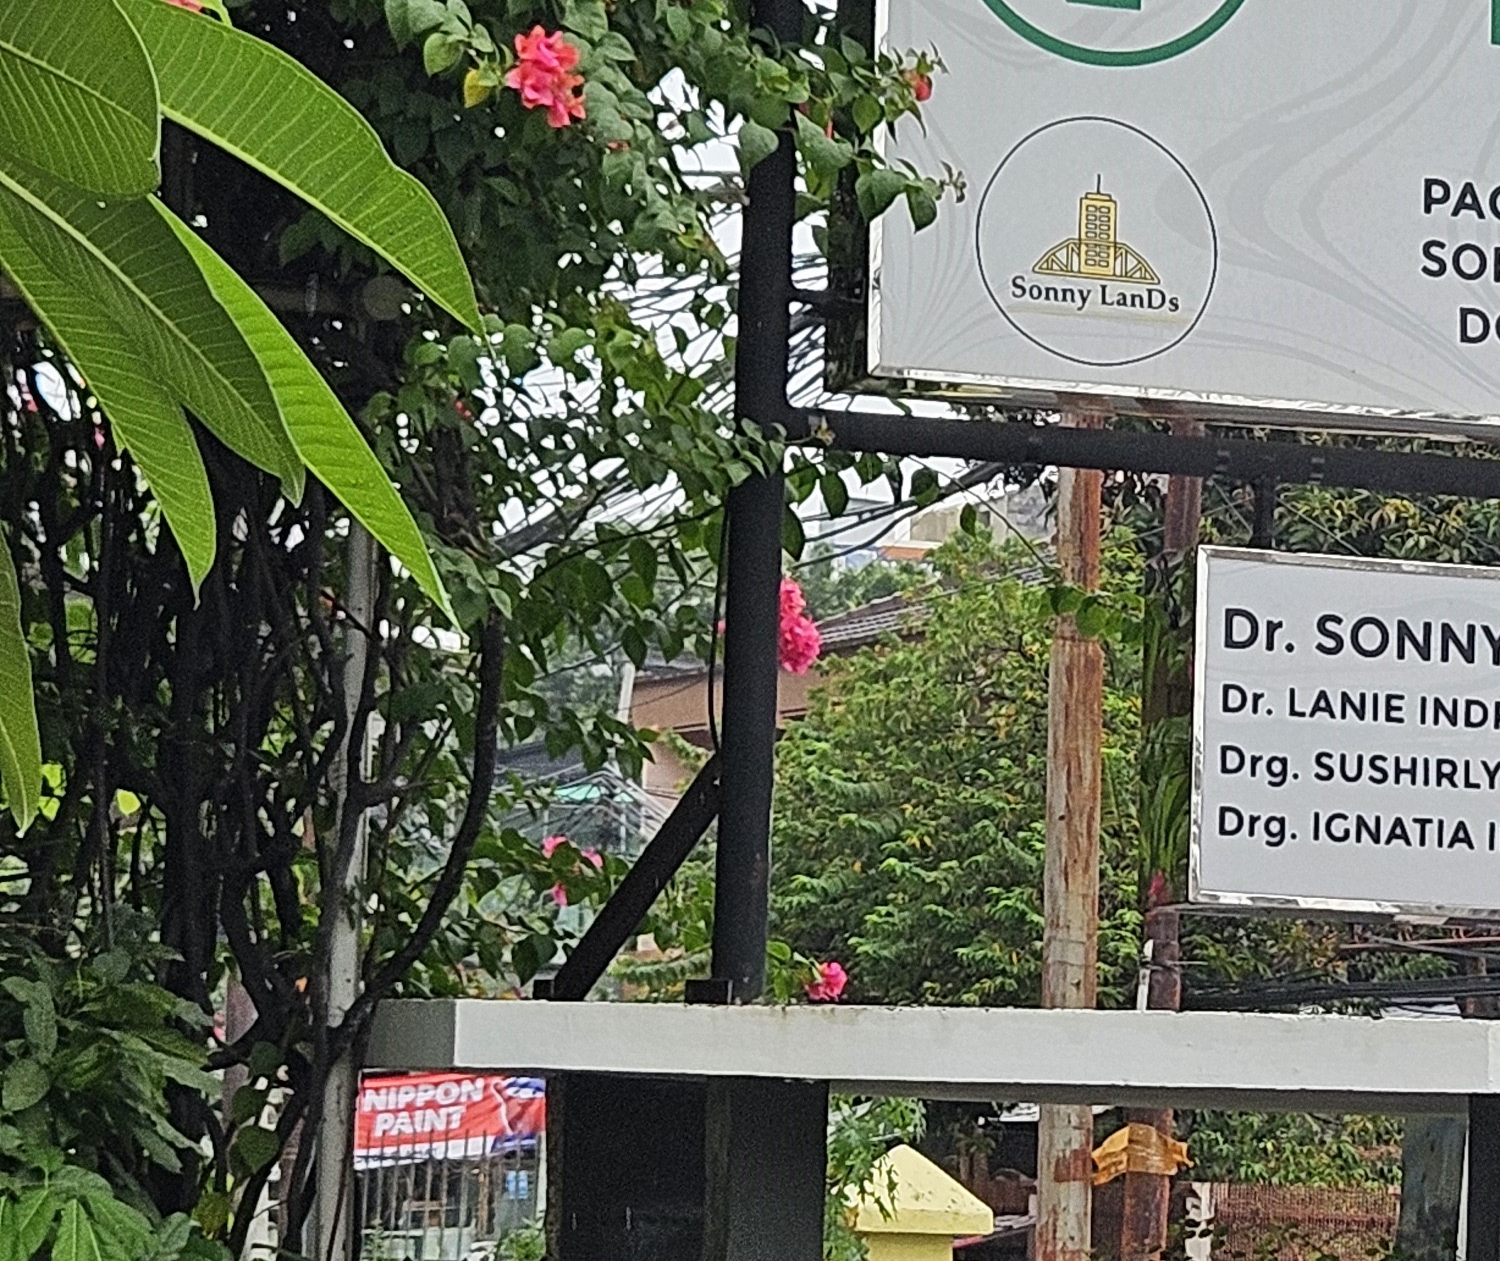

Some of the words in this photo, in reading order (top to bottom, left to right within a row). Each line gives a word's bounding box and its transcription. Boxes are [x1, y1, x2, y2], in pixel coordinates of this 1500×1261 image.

[1011, 274, 1092, 311] Sonny
[1099, 284, 1180, 313] LanDs
[1224, 607, 1295, 653] Dr.
[1222, 683, 1273, 716] Dr.
[1288, 687, 1406, 724] LANIE
[1220, 744, 1299, 788] Drg.
[1218, 805, 1297, 848] Drg.
[1312, 811, 1475, 851] IGNATIA
[363, 1077, 485, 1112] NIPPON
[374, 1106, 466, 1137] PAINT
